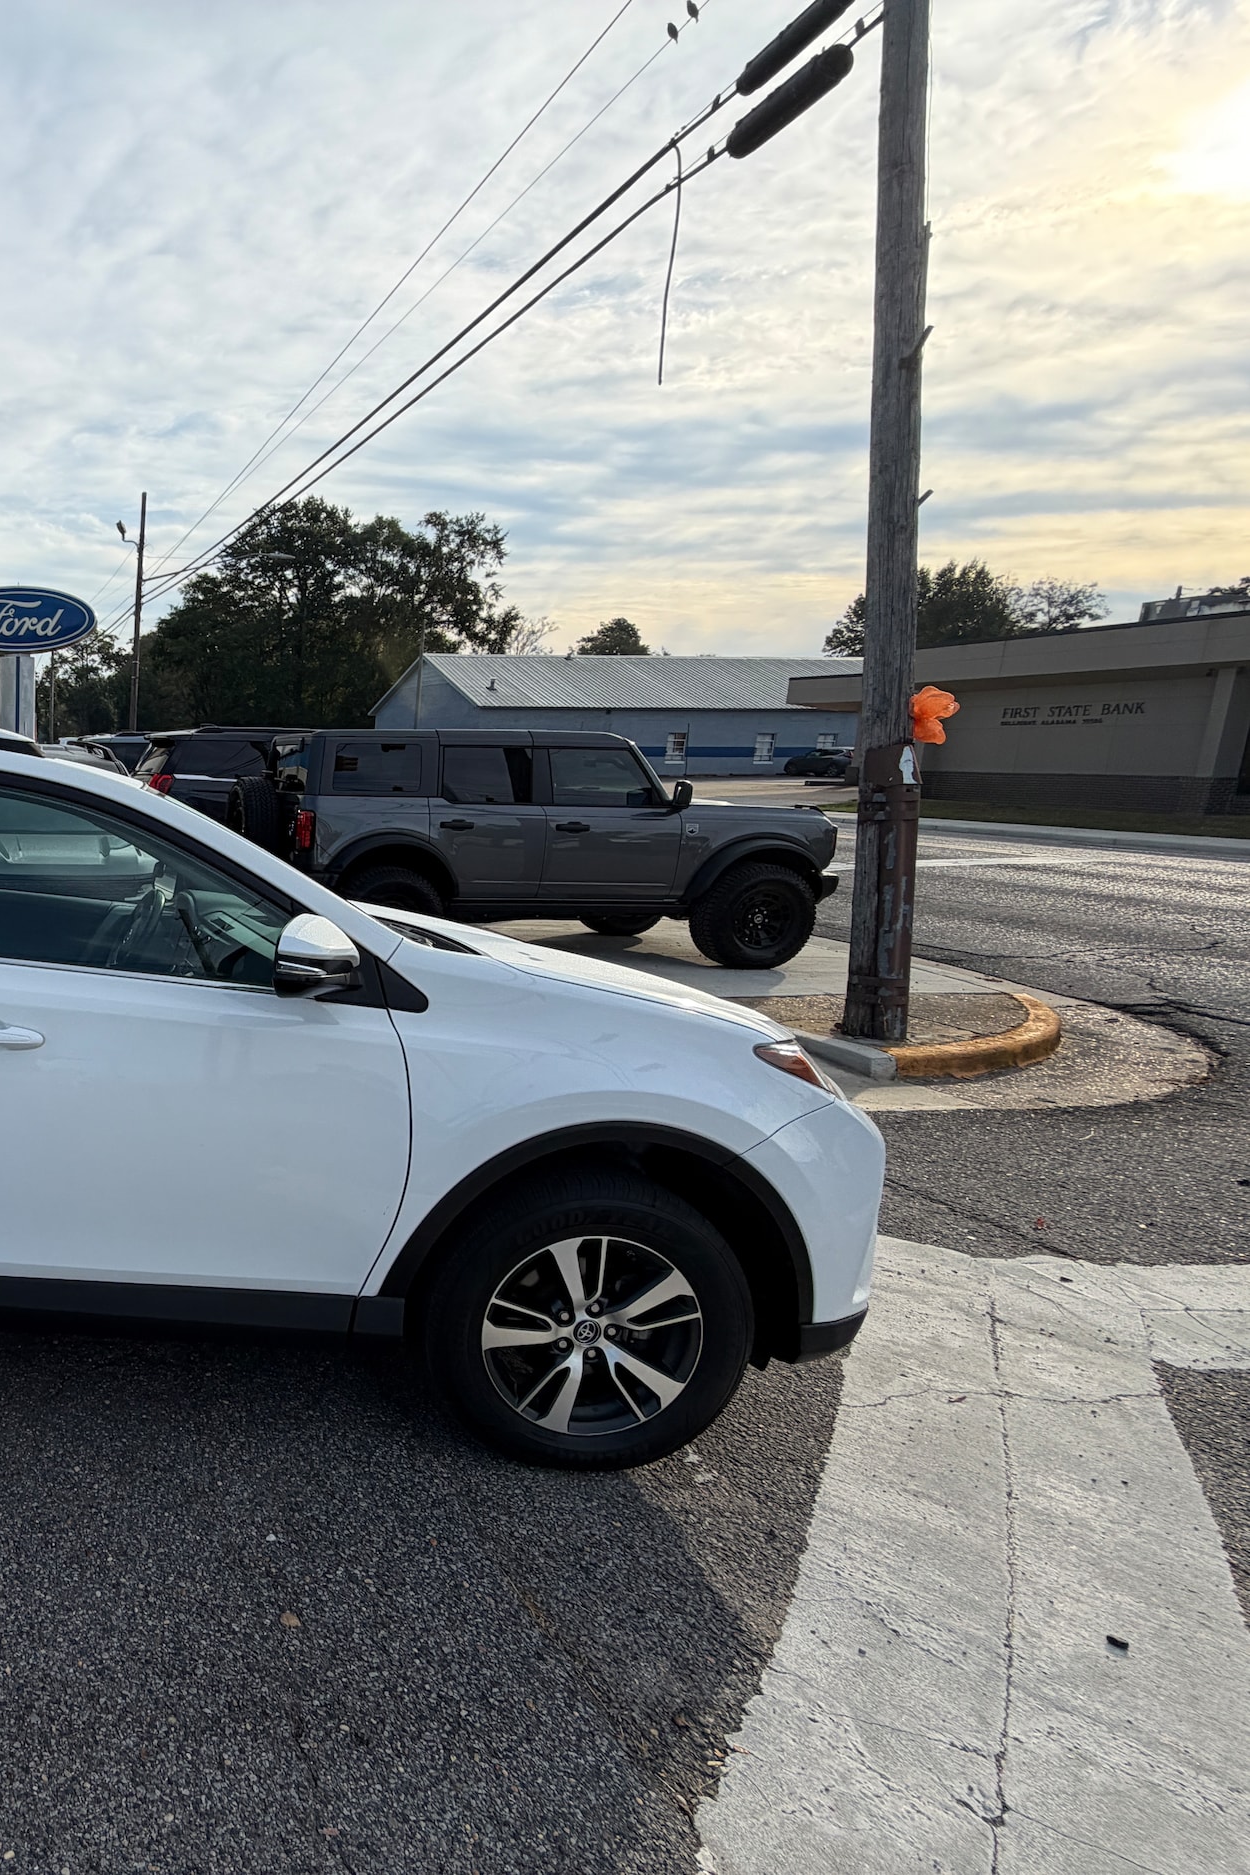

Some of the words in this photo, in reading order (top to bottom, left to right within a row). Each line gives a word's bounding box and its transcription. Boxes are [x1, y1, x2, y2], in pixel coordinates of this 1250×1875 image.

[1002, 707, 1040, 718] FIRST
[1047, 705, 1092, 717] STATE
[1101, 702, 1145, 715] BANK
